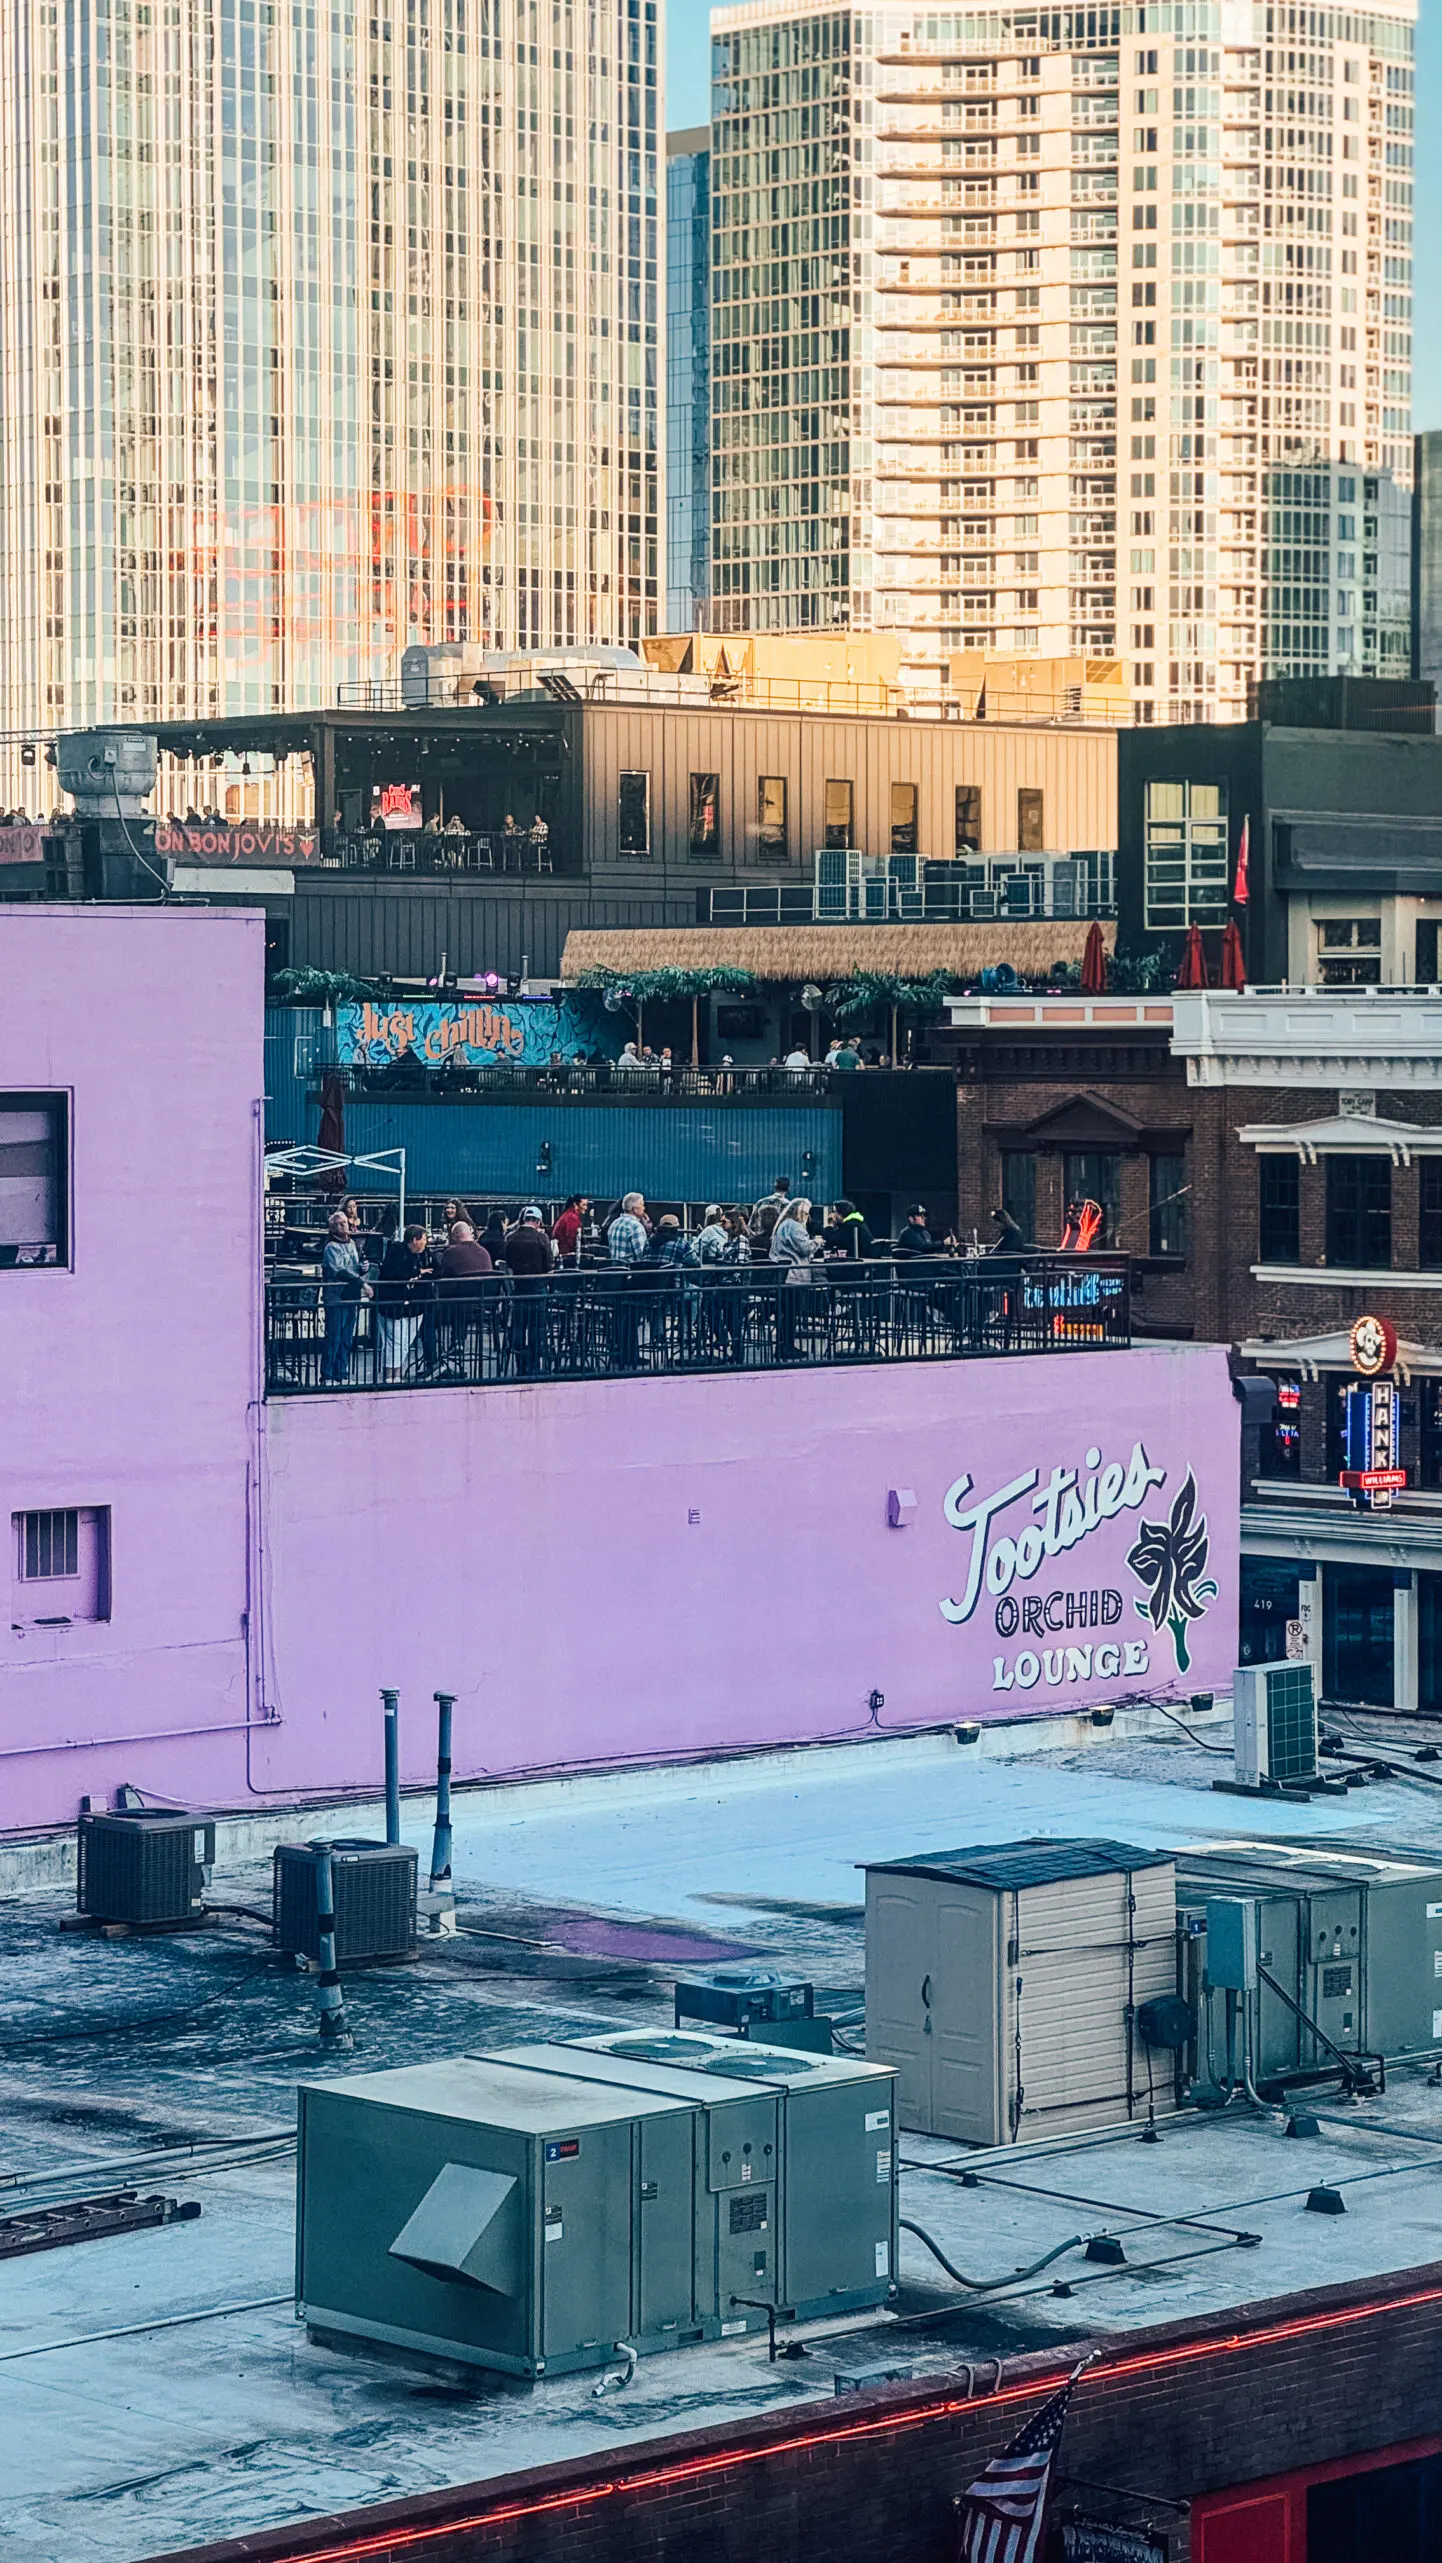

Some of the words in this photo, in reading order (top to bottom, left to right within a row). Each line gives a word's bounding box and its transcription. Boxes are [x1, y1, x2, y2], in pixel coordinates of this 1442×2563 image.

[189, 832, 231, 854] BON
[230, 833, 296, 863] JOVI'S
[1375, 1385, 1390, 1469] HANK
[1364, 1474, 1403, 1486] WILLIAMS
[939, 1441, 1168, 1624] Tootsies
[995, 1589, 1123, 1638] ORCHID
[1254, 1599, 1273, 1610] 419
[992, 1639, 1150, 1691] LOUNGE
[550, 2148, 557, 2158] 2
